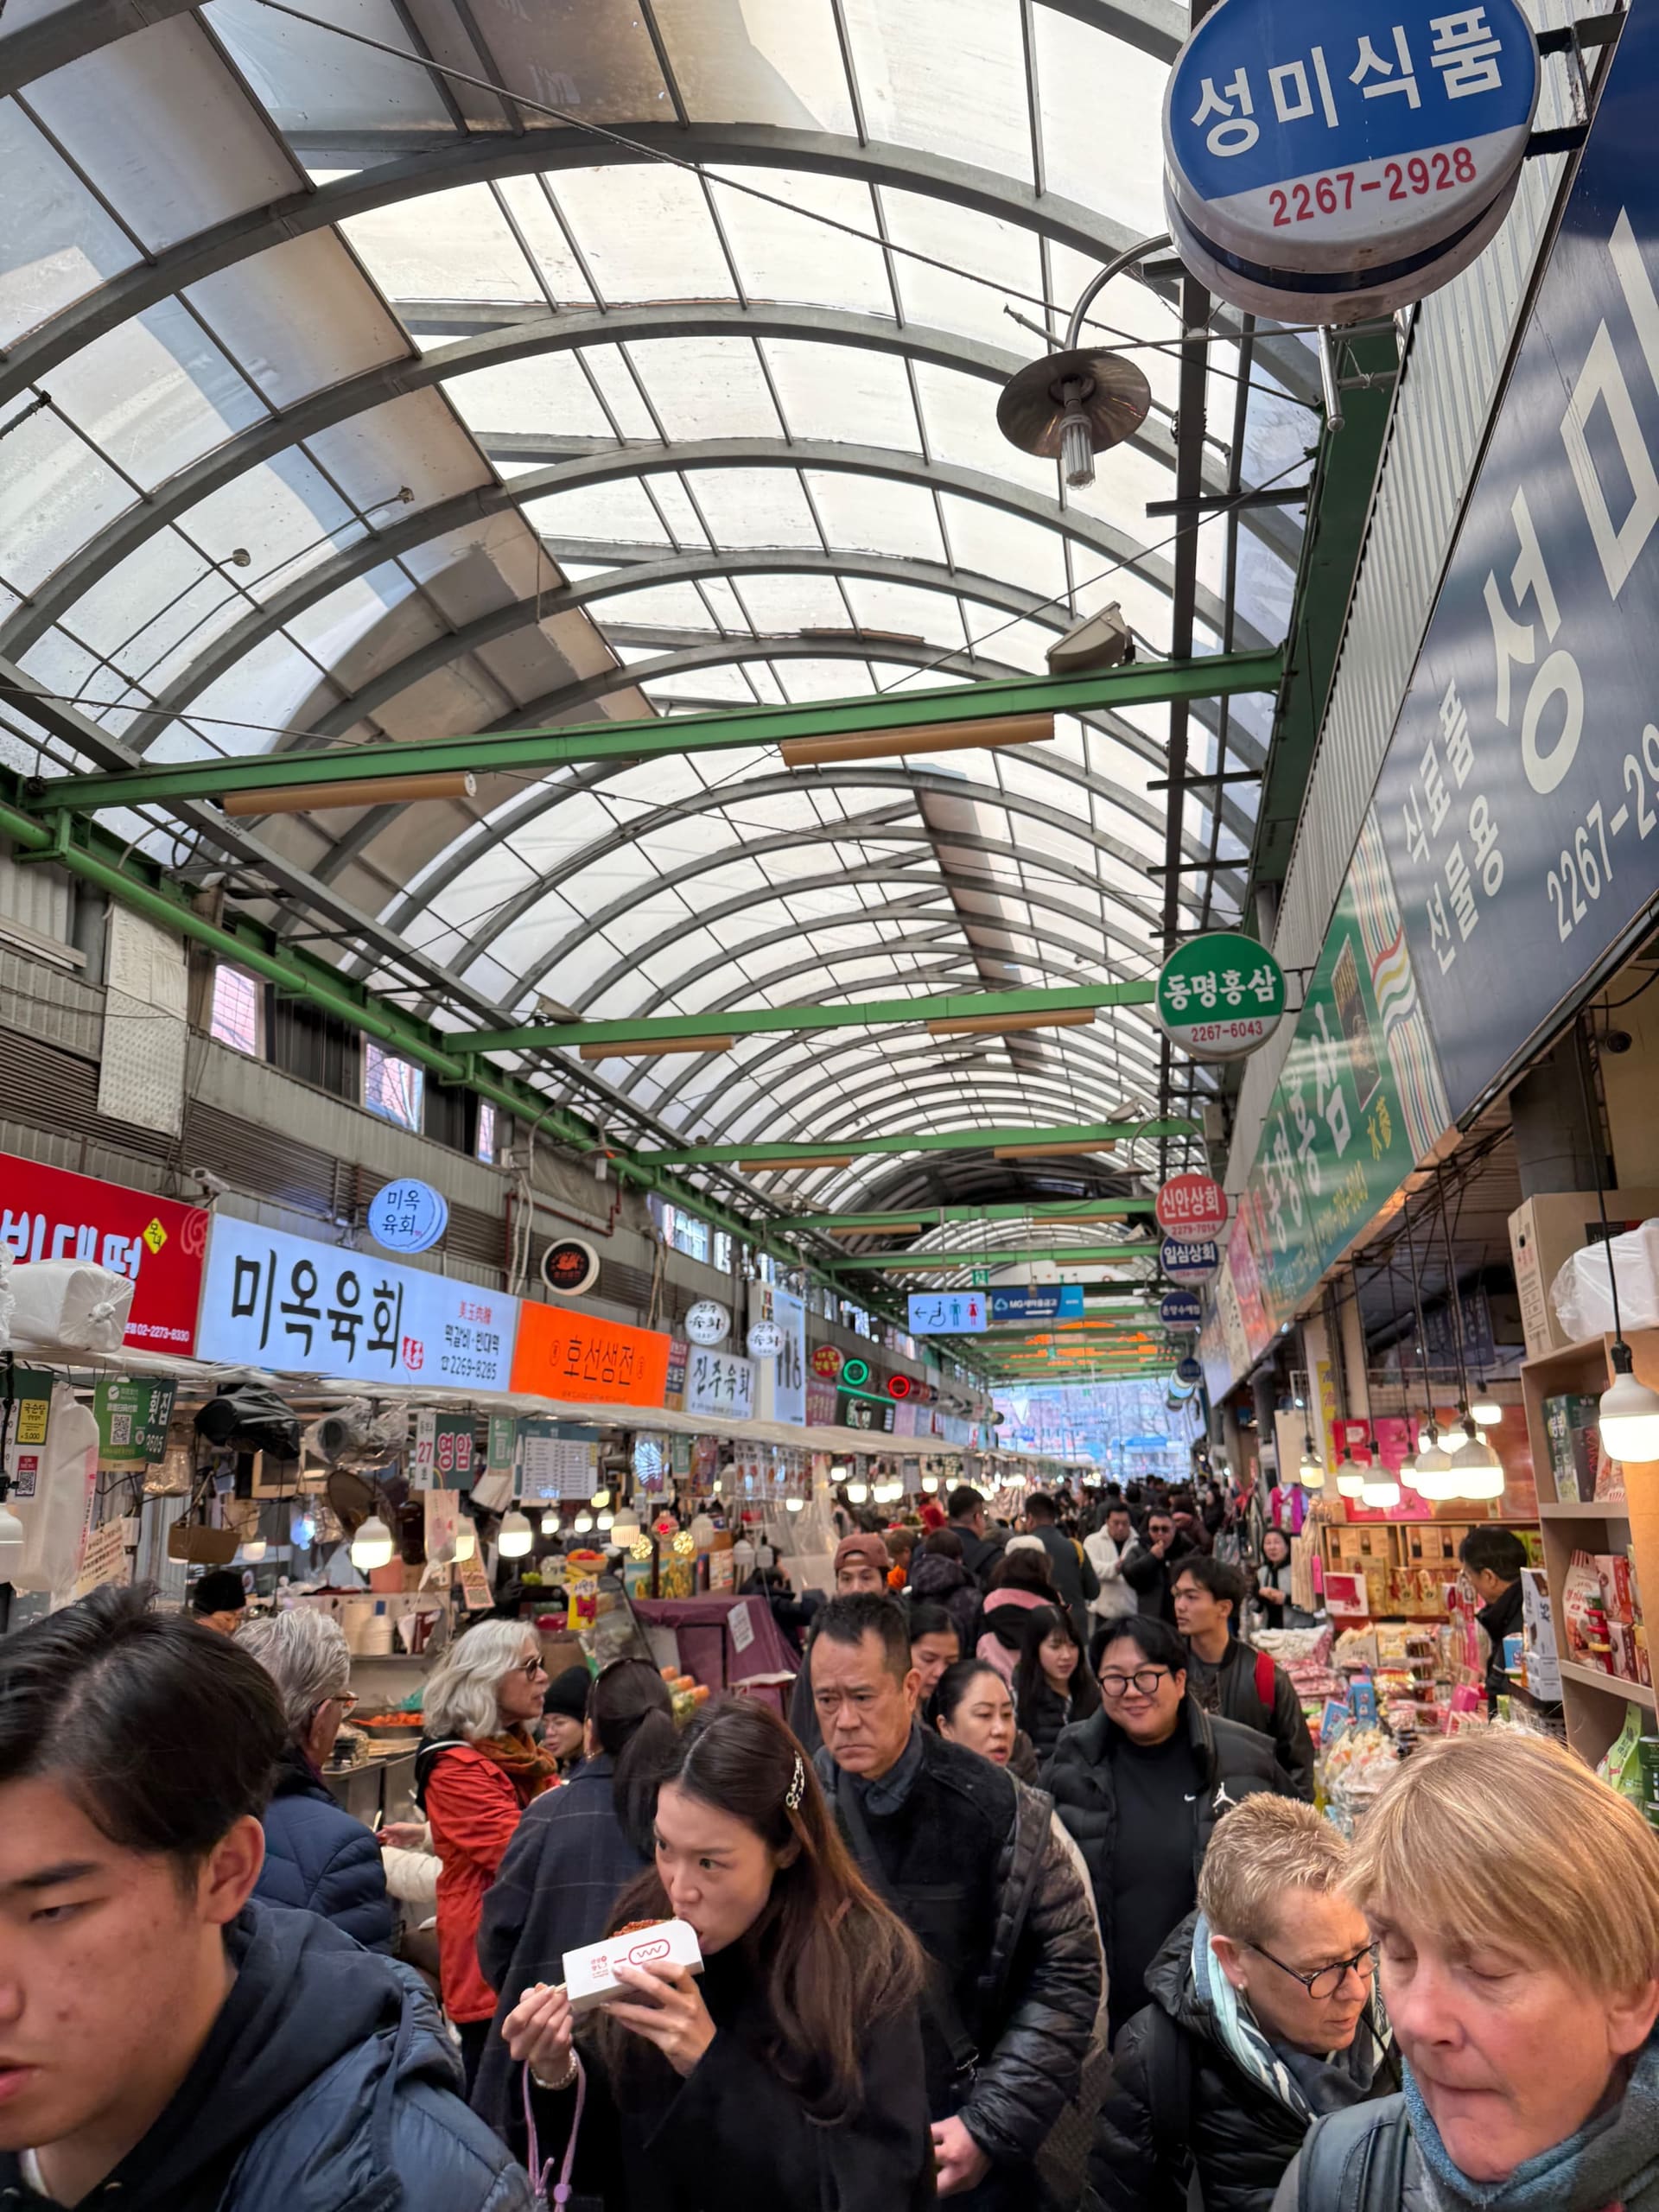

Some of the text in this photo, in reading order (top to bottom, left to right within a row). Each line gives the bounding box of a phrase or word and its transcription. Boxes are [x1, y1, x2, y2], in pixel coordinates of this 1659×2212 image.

[1191, 6, 1503, 157] 성미식품
[1268, 146, 1478, 227] 2267-2928
[1403, 678, 1474, 864] 식료품
[1427, 794, 1503, 975] 선물용
[1164, 964, 1276, 1010] 동명홍삼
[1191, 1020, 1263, 1042] 2267-6043
[387, 1189, 421, 1211] 미옥
[1162, 1185, 1220, 1219] 신안상회
[382, 1214, 416, 1236] 육회
[1164, 1243, 1216, 1264] 일심상회
[232, 1249, 404, 1370] 미옥육회
[148, 1390, 172, 1426] 횟집
[418, 1441, 433, 1464] 27
[438, 1433, 472, 1471] 영암
